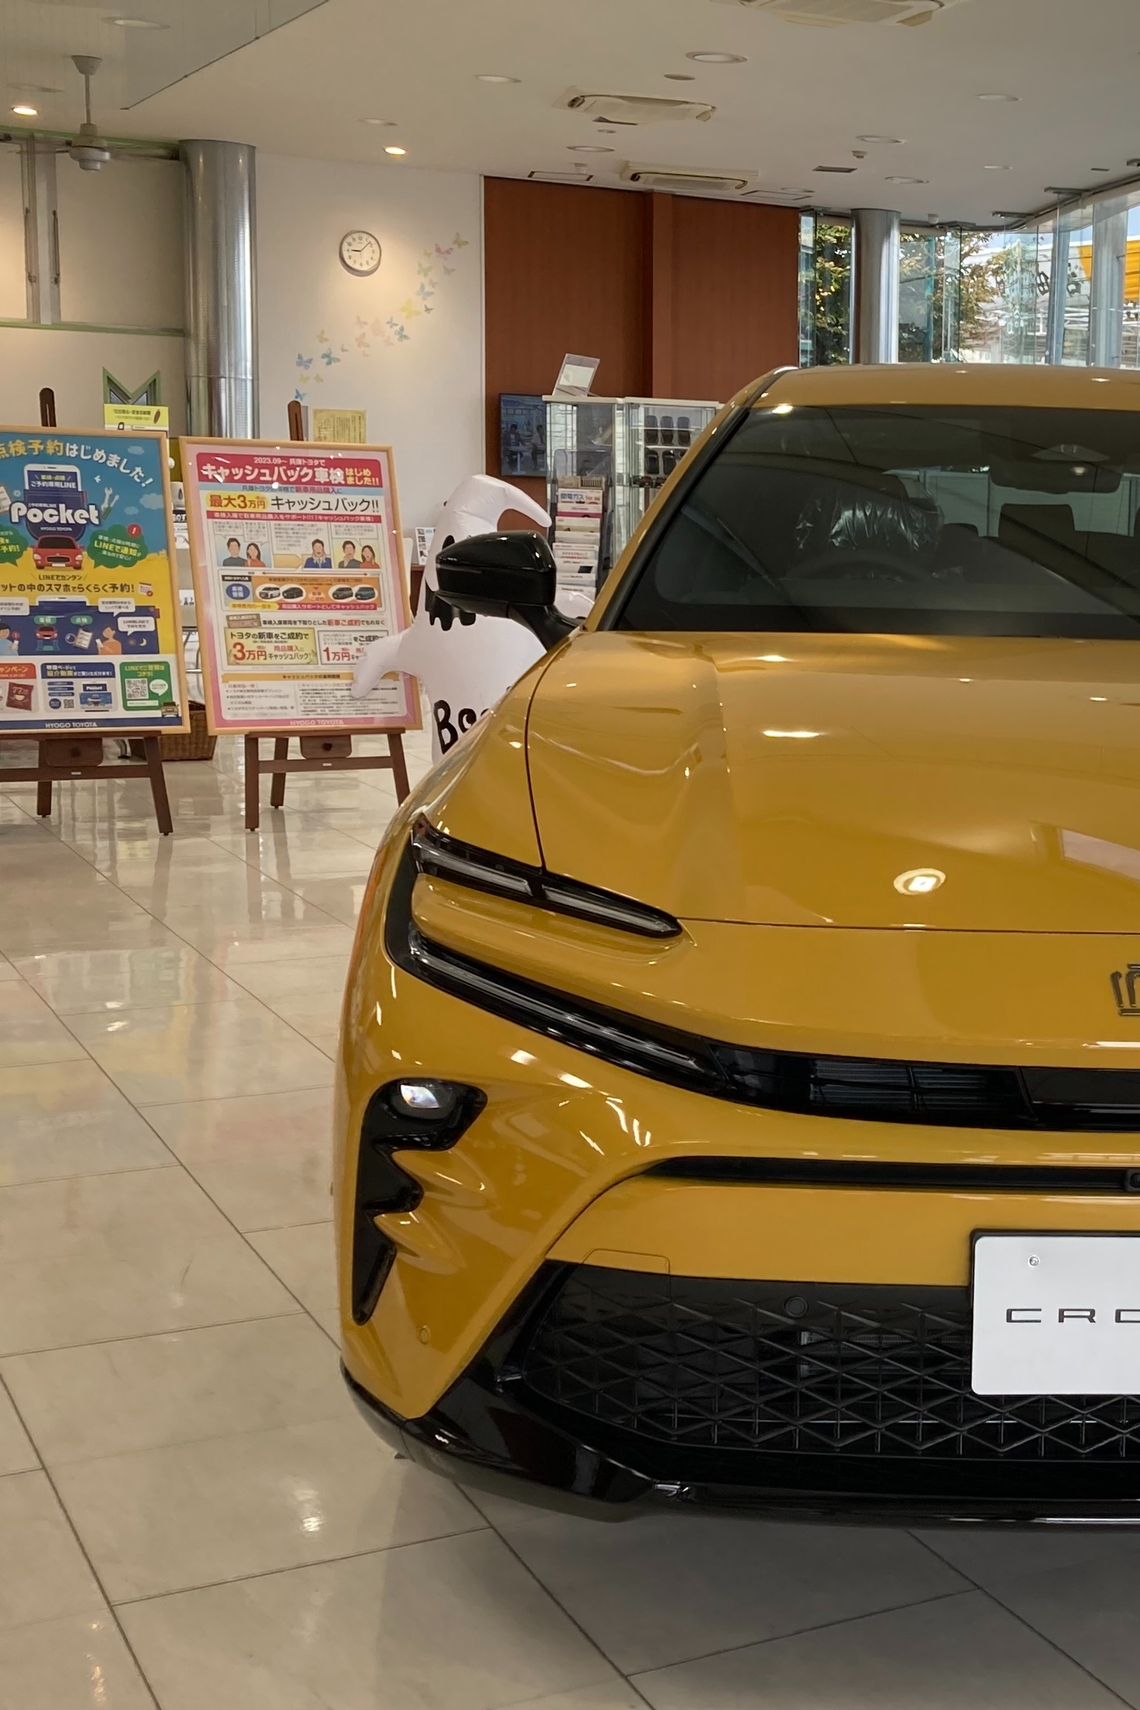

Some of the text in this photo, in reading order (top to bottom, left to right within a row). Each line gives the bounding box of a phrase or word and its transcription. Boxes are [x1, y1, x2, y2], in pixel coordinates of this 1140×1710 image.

[201, 462, 345, 485] キャッシュバック車検
[345, 468, 372, 477] はじめ
[209, 494, 266, 509] 最大3万円
[11, 502, 99, 525] Pocket
[230, 631, 309, 640] トヨタの新車をご成約で
[232, 642, 267, 661] 3万円
[323, 646, 351, 662] 1万円
[433, 699, 490, 755] Bo
